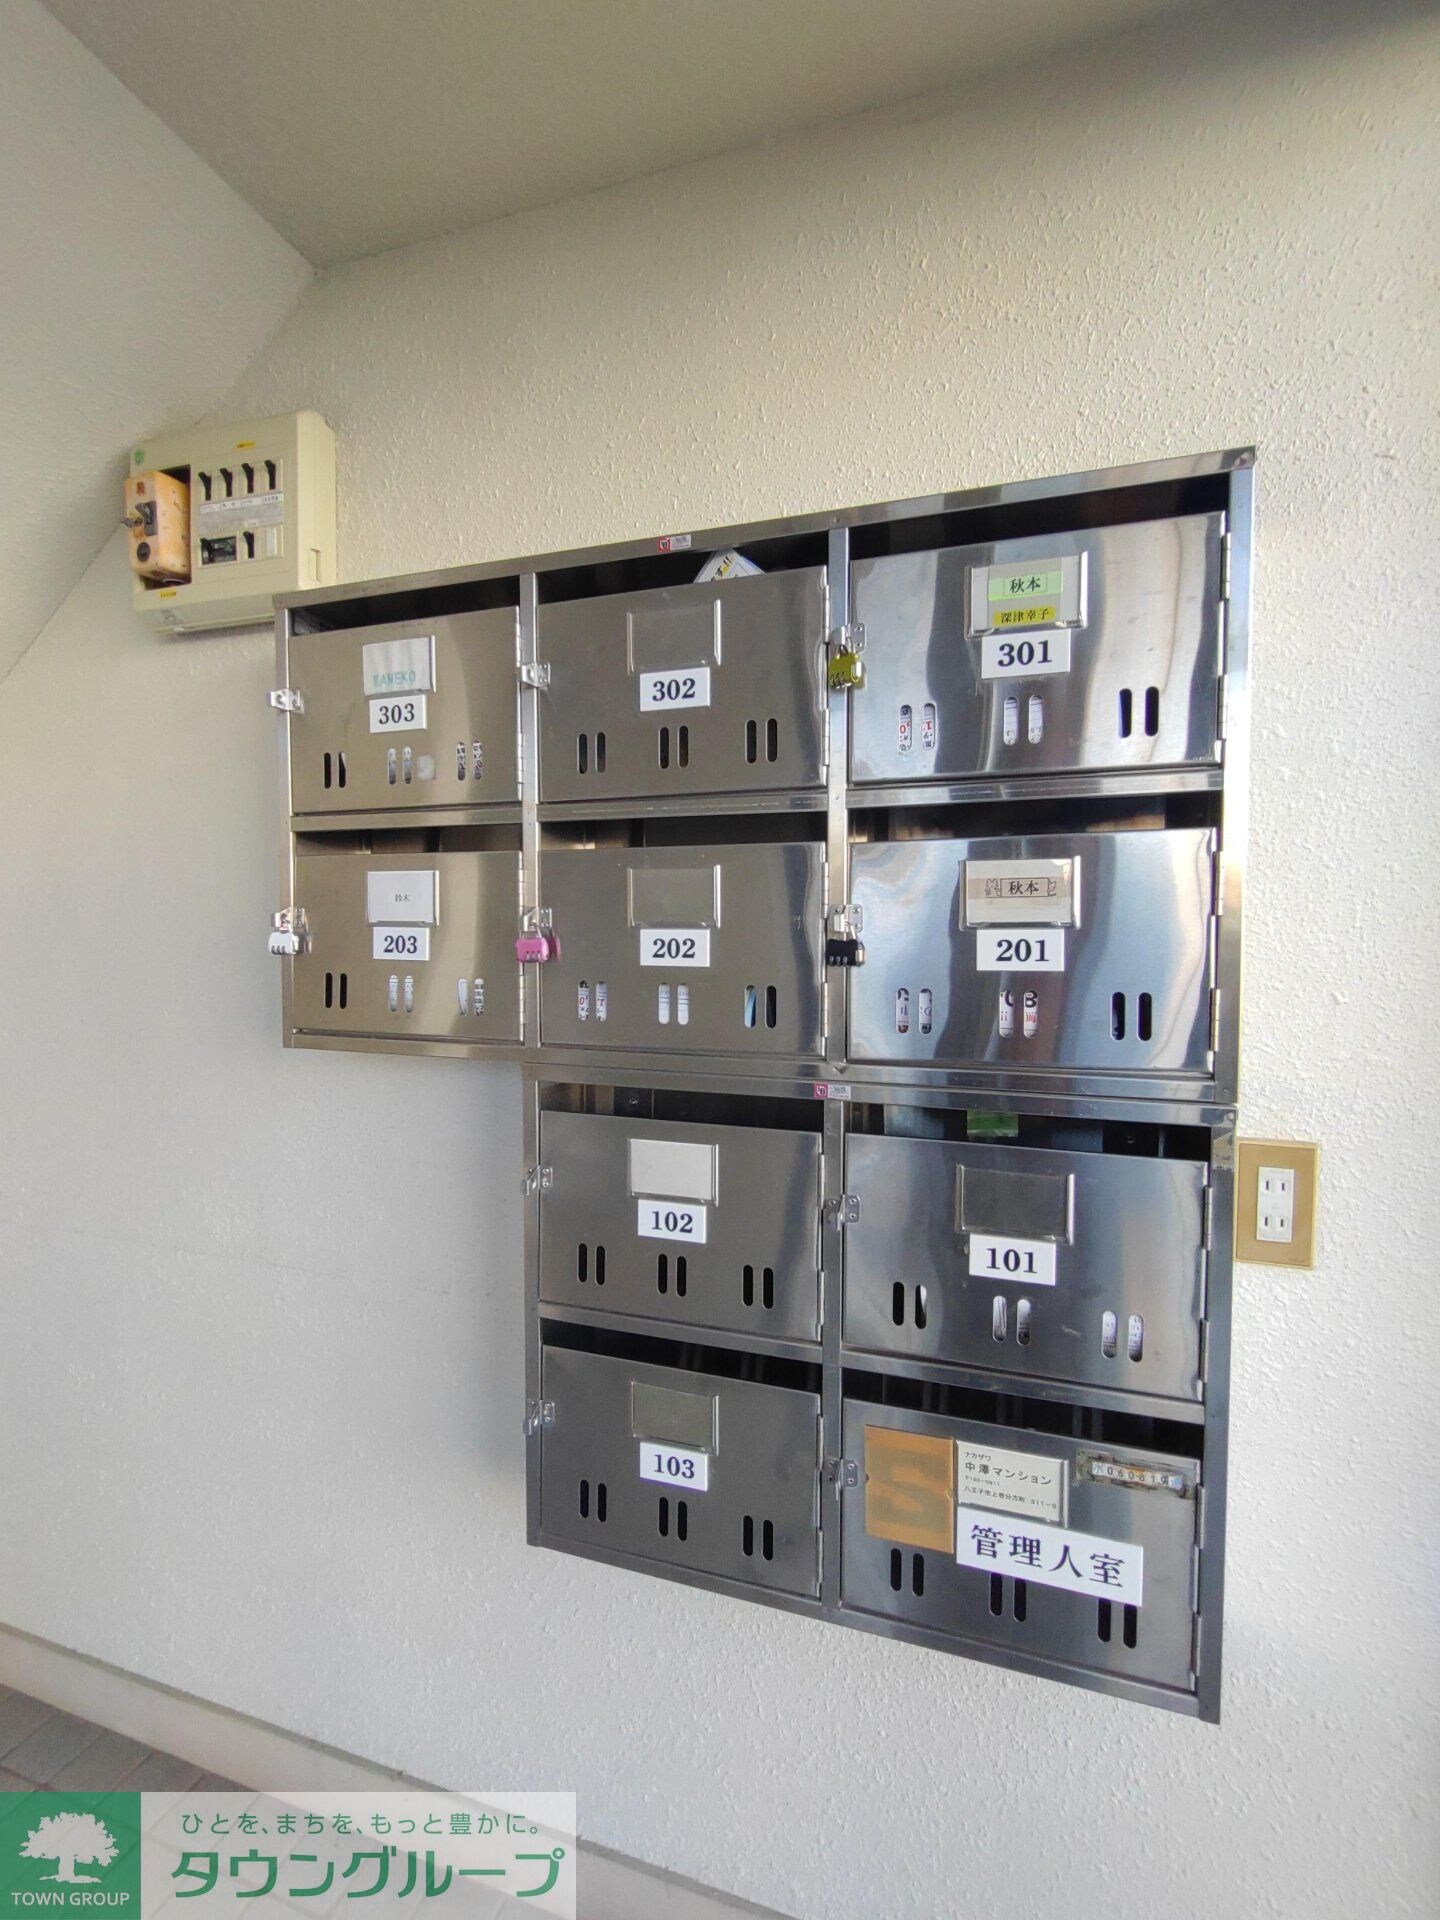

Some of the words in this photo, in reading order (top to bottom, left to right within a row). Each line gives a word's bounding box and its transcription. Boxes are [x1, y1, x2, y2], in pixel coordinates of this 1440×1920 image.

[1009, 576, 1041, 593] 秋本
[1000, 608, 1049, 624] 深津幸子
[997, 640, 1053, 667] 301
[652, 678, 696, 702] 302
[378, 703, 415, 725] 303
[1008, 880, 1040, 896] 秋本
[383, 935, 418, 954] 203
[652, 938, 696, 959] 202
[996, 939, 1050, 962] 201
[651, 1210, 693, 1233] 102
[986, 1247, 1037, 1274] 101
[653, 1454, 695, 1479] 103
[971, 1524, 1126, 1588] 管理人室
